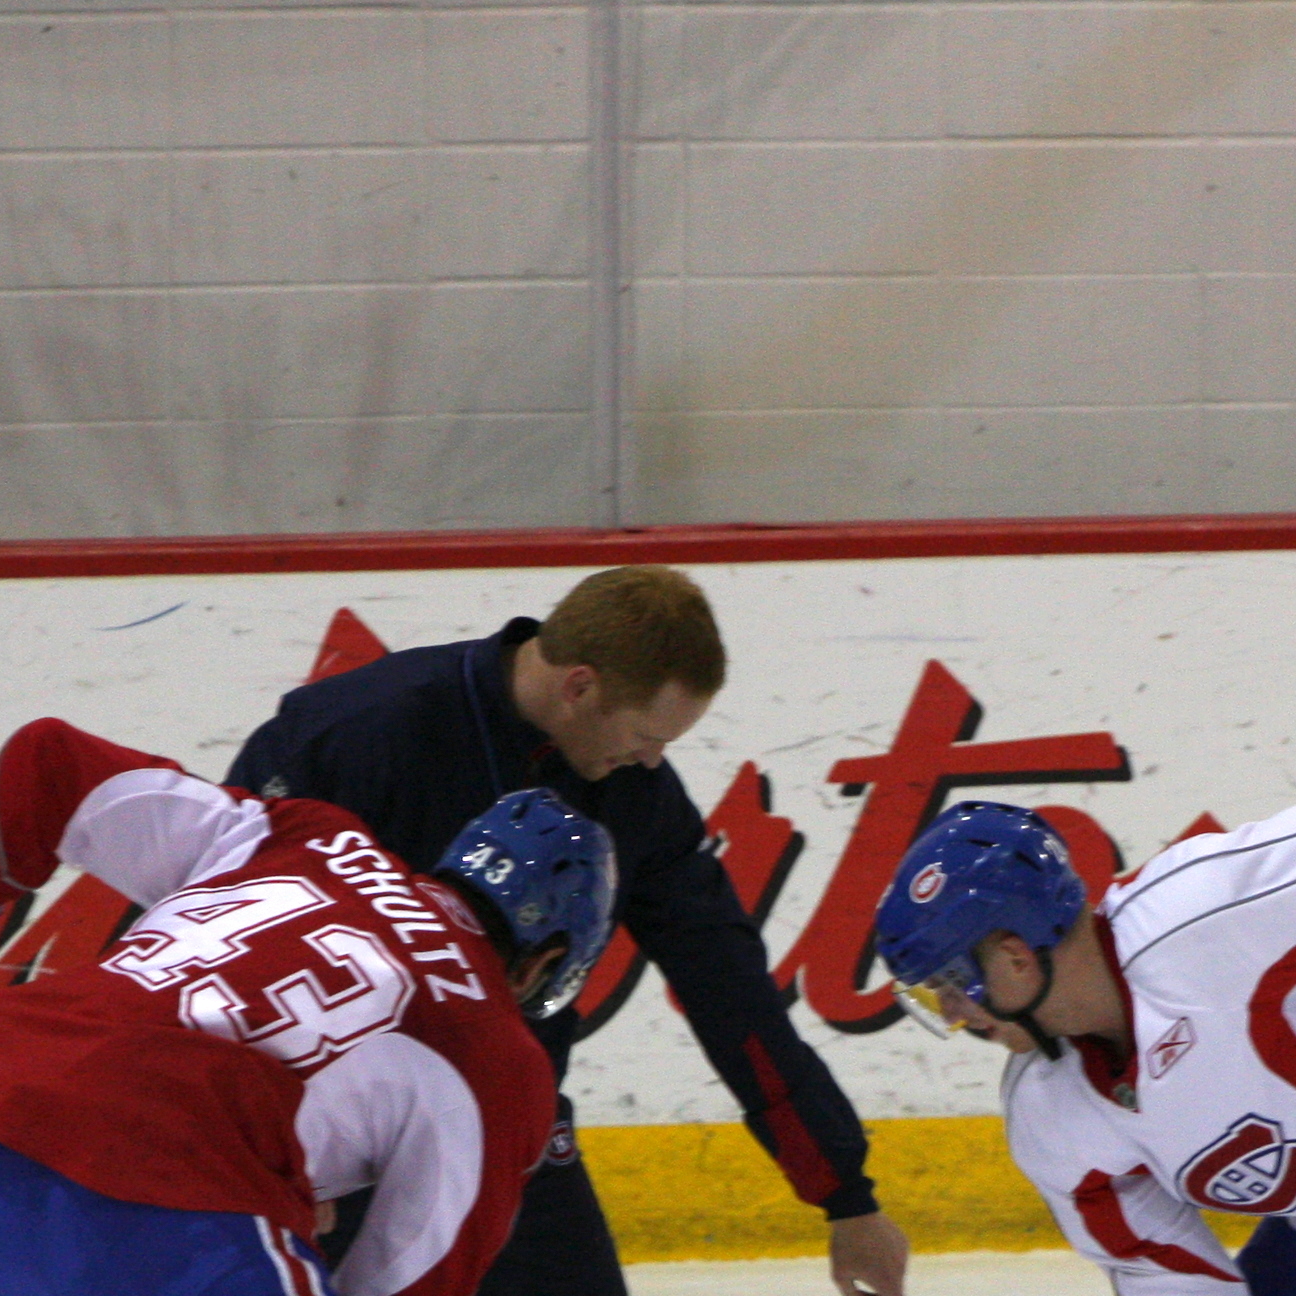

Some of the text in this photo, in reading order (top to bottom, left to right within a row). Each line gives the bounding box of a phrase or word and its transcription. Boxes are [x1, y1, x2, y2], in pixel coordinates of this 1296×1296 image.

[306, 829, 485, 1003] SCHULTZ
[465, 846, 515, 885] 43
[101, 875, 417, 1069] 43
